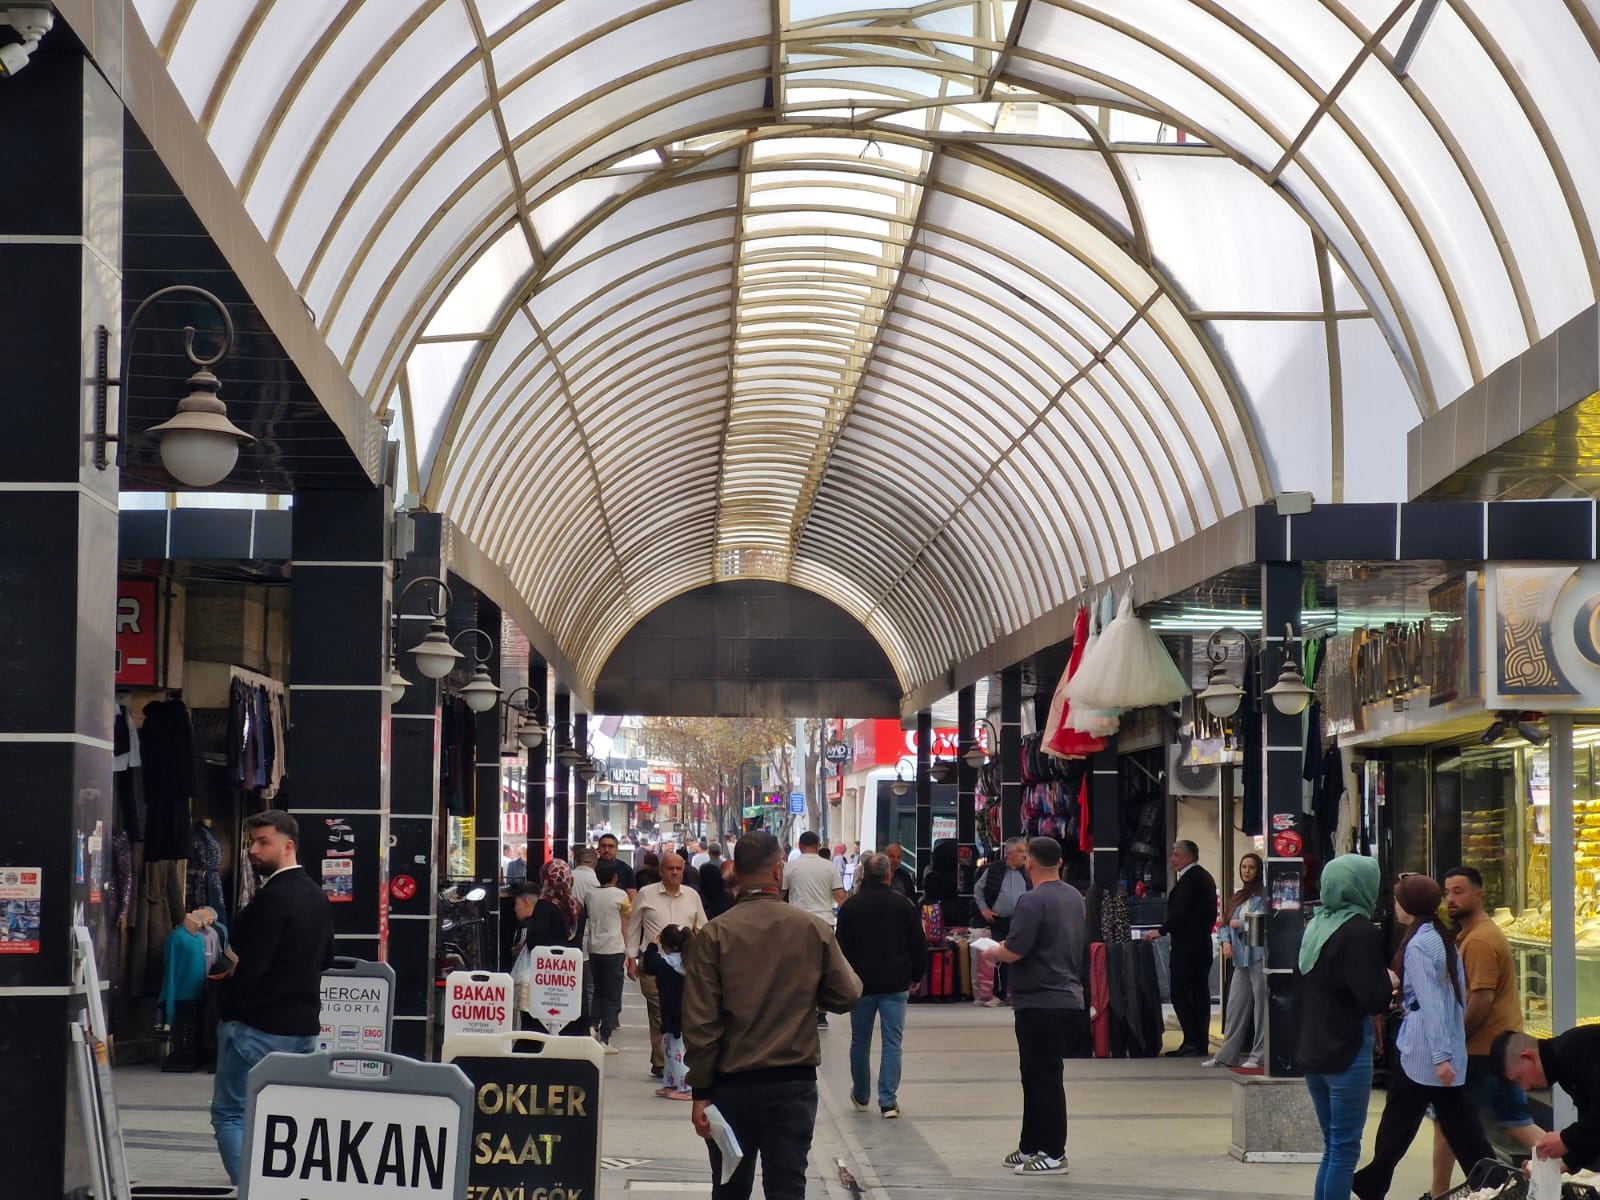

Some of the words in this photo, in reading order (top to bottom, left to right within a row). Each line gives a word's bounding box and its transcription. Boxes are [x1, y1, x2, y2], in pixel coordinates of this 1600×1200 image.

[536, 957, 577, 973] BAKAN
[535, 971, 577, 990] GÜMÜŞ
[453, 985, 506, 1002] BAKAN
[451, 1001, 506, 1026] GÜMÜŞ
[364, 1029, 382, 1038] ERGO
[363, 1062, 379, 1070] HDI
[477, 1082, 588, 1117] OKLER
[261, 1113, 448, 1190] BAKAN
[475, 1132, 562, 1166] SAAT
